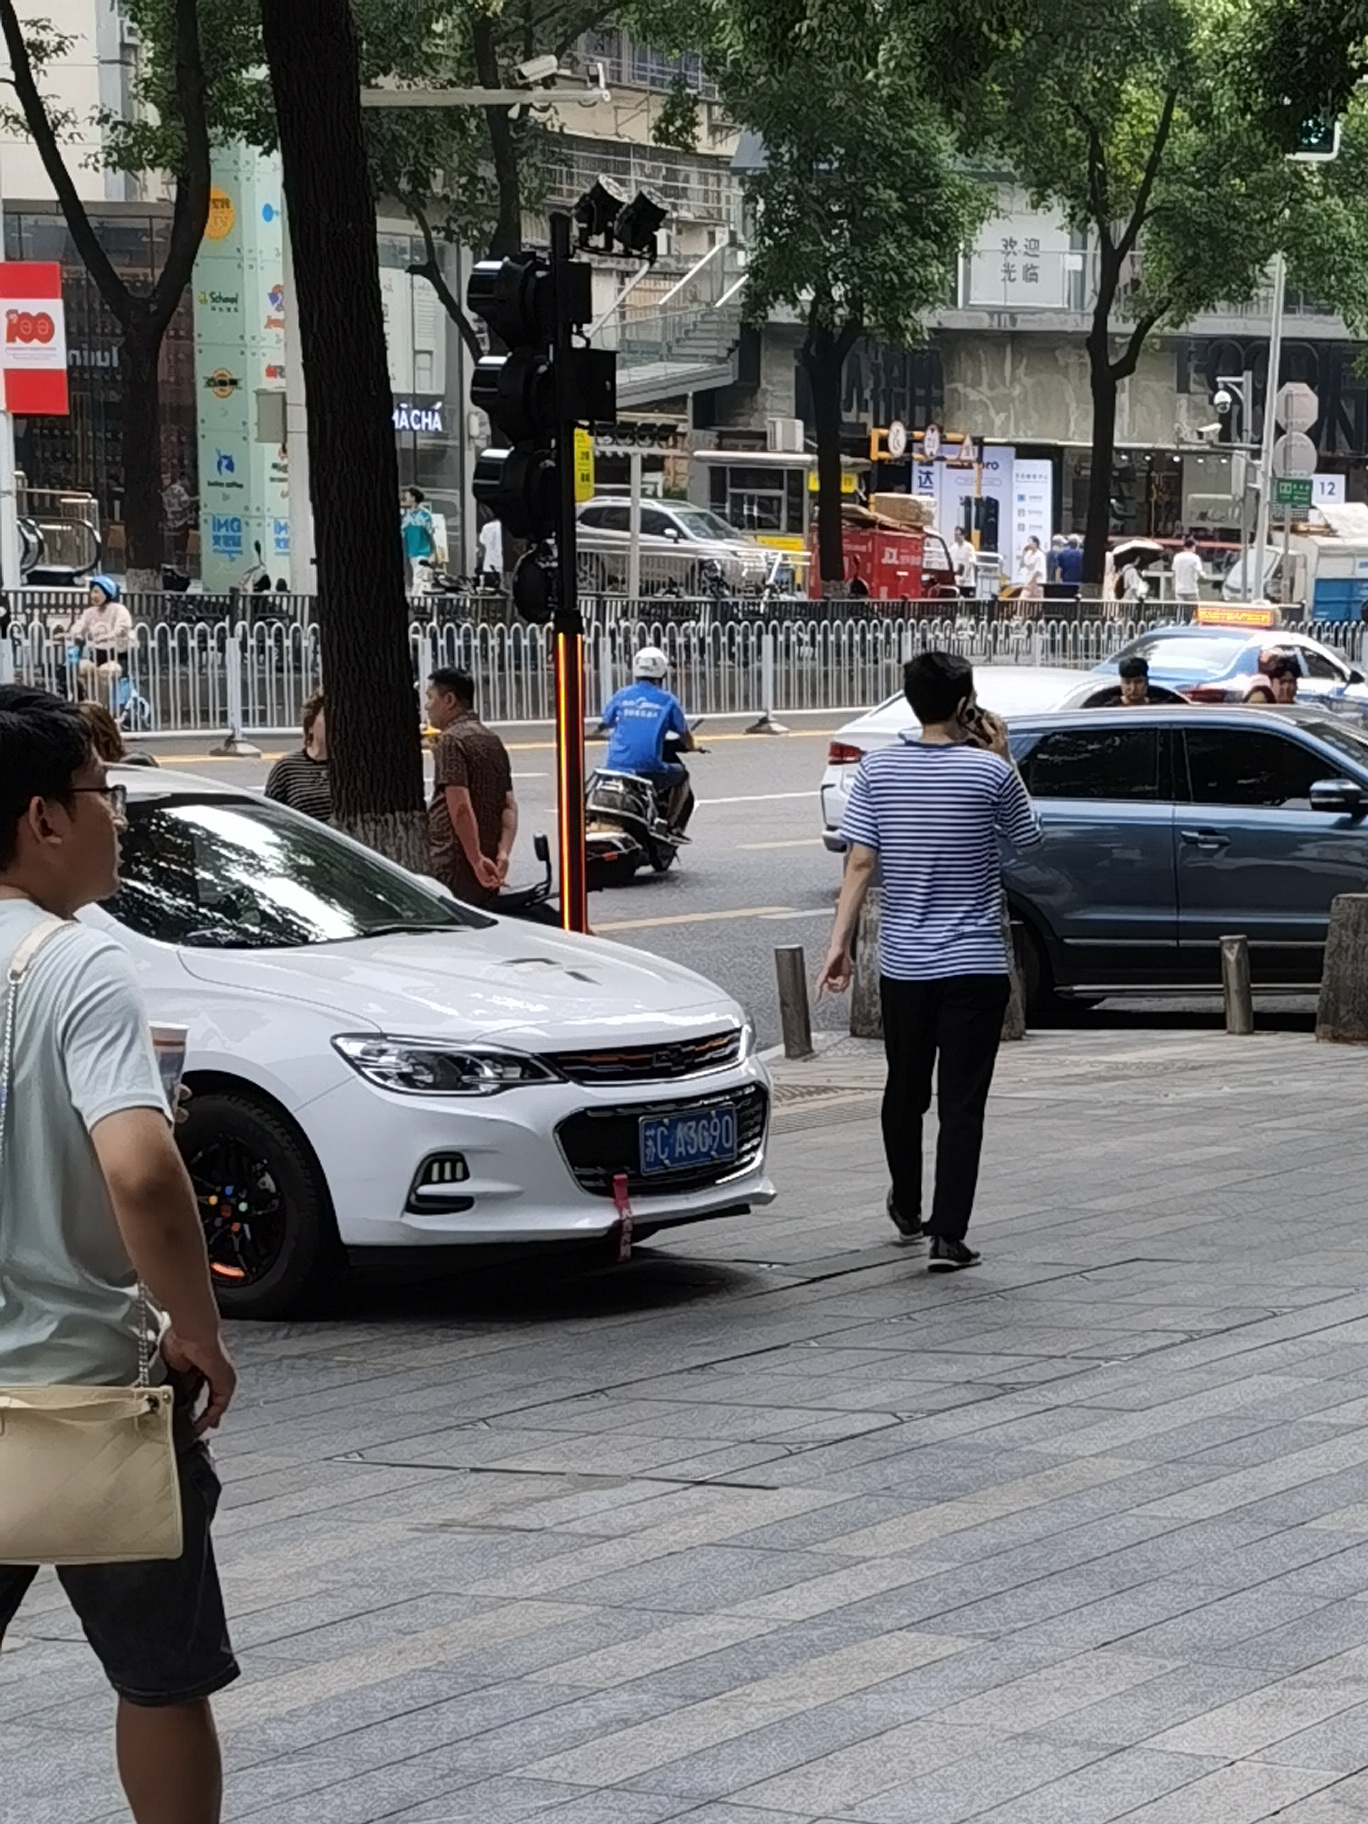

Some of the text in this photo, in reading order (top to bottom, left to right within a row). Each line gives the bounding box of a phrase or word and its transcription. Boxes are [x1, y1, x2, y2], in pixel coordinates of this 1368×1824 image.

[1001, 237, 1040, 258] 欢迎
[1001, 262, 1039, 283] 光临
[1319, 481, 1336, 496] 12
